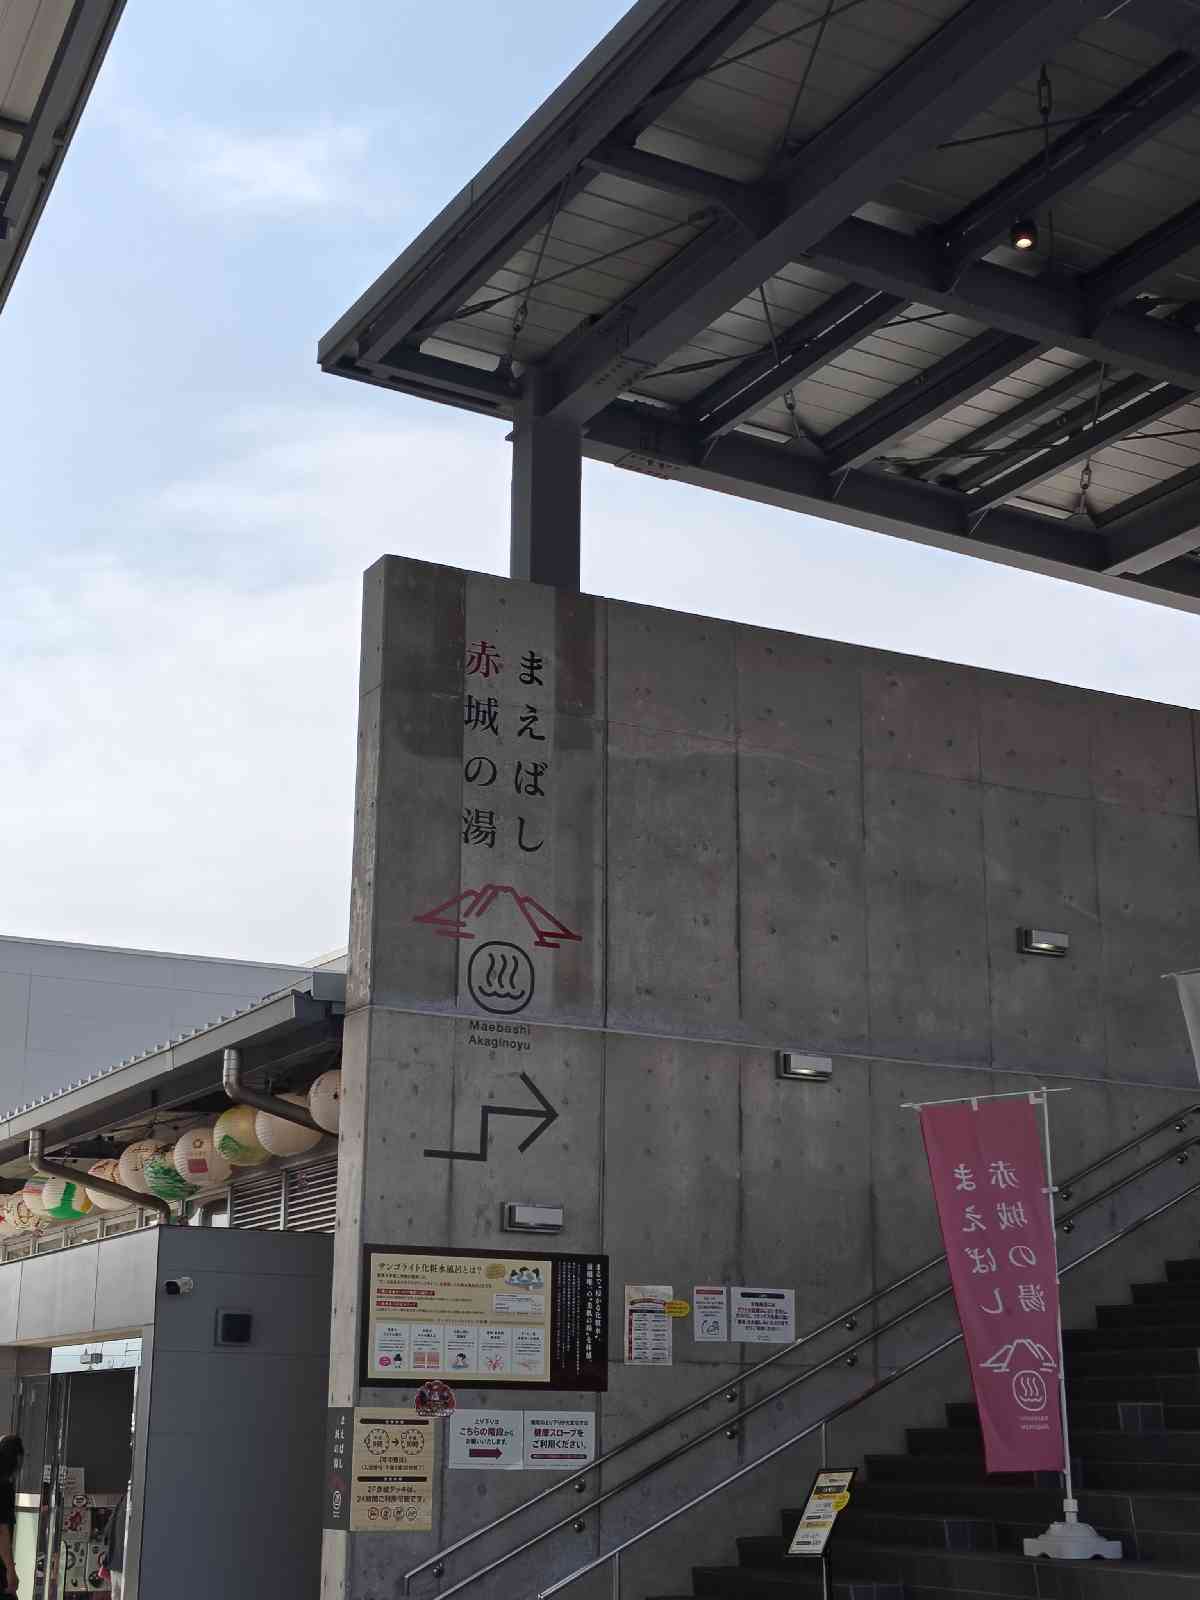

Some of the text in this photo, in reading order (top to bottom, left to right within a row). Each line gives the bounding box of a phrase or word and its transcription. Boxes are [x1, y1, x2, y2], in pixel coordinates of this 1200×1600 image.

[462, 640, 501, 850] 赤城の湯
[514, 650, 548, 853] まえばし
[468, 1035, 531, 1051] Akaginoyu
[470, 1020, 530, 1034] Maebashi
